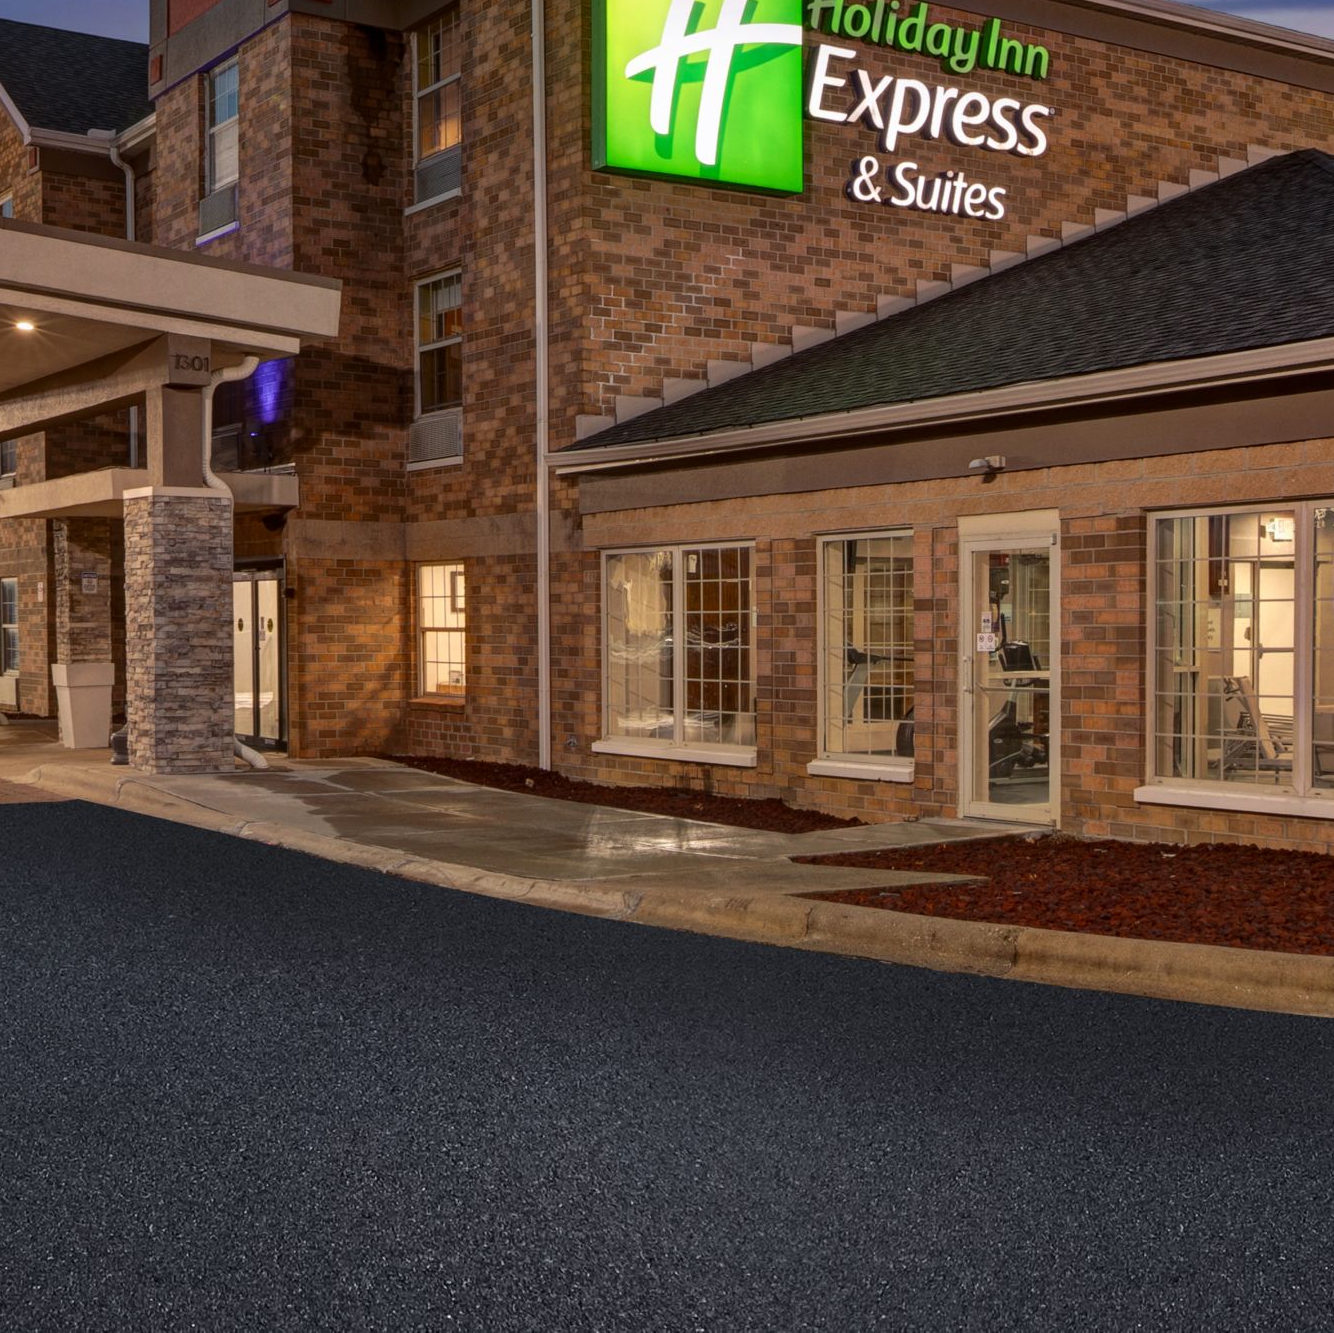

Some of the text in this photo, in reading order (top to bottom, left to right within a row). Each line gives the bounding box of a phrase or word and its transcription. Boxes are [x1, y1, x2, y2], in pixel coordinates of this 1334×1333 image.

[986, 17, 1050, 80] Inn
[808, 44, 1050, 157] Express
[852, 156, 1007, 221] & Suites
